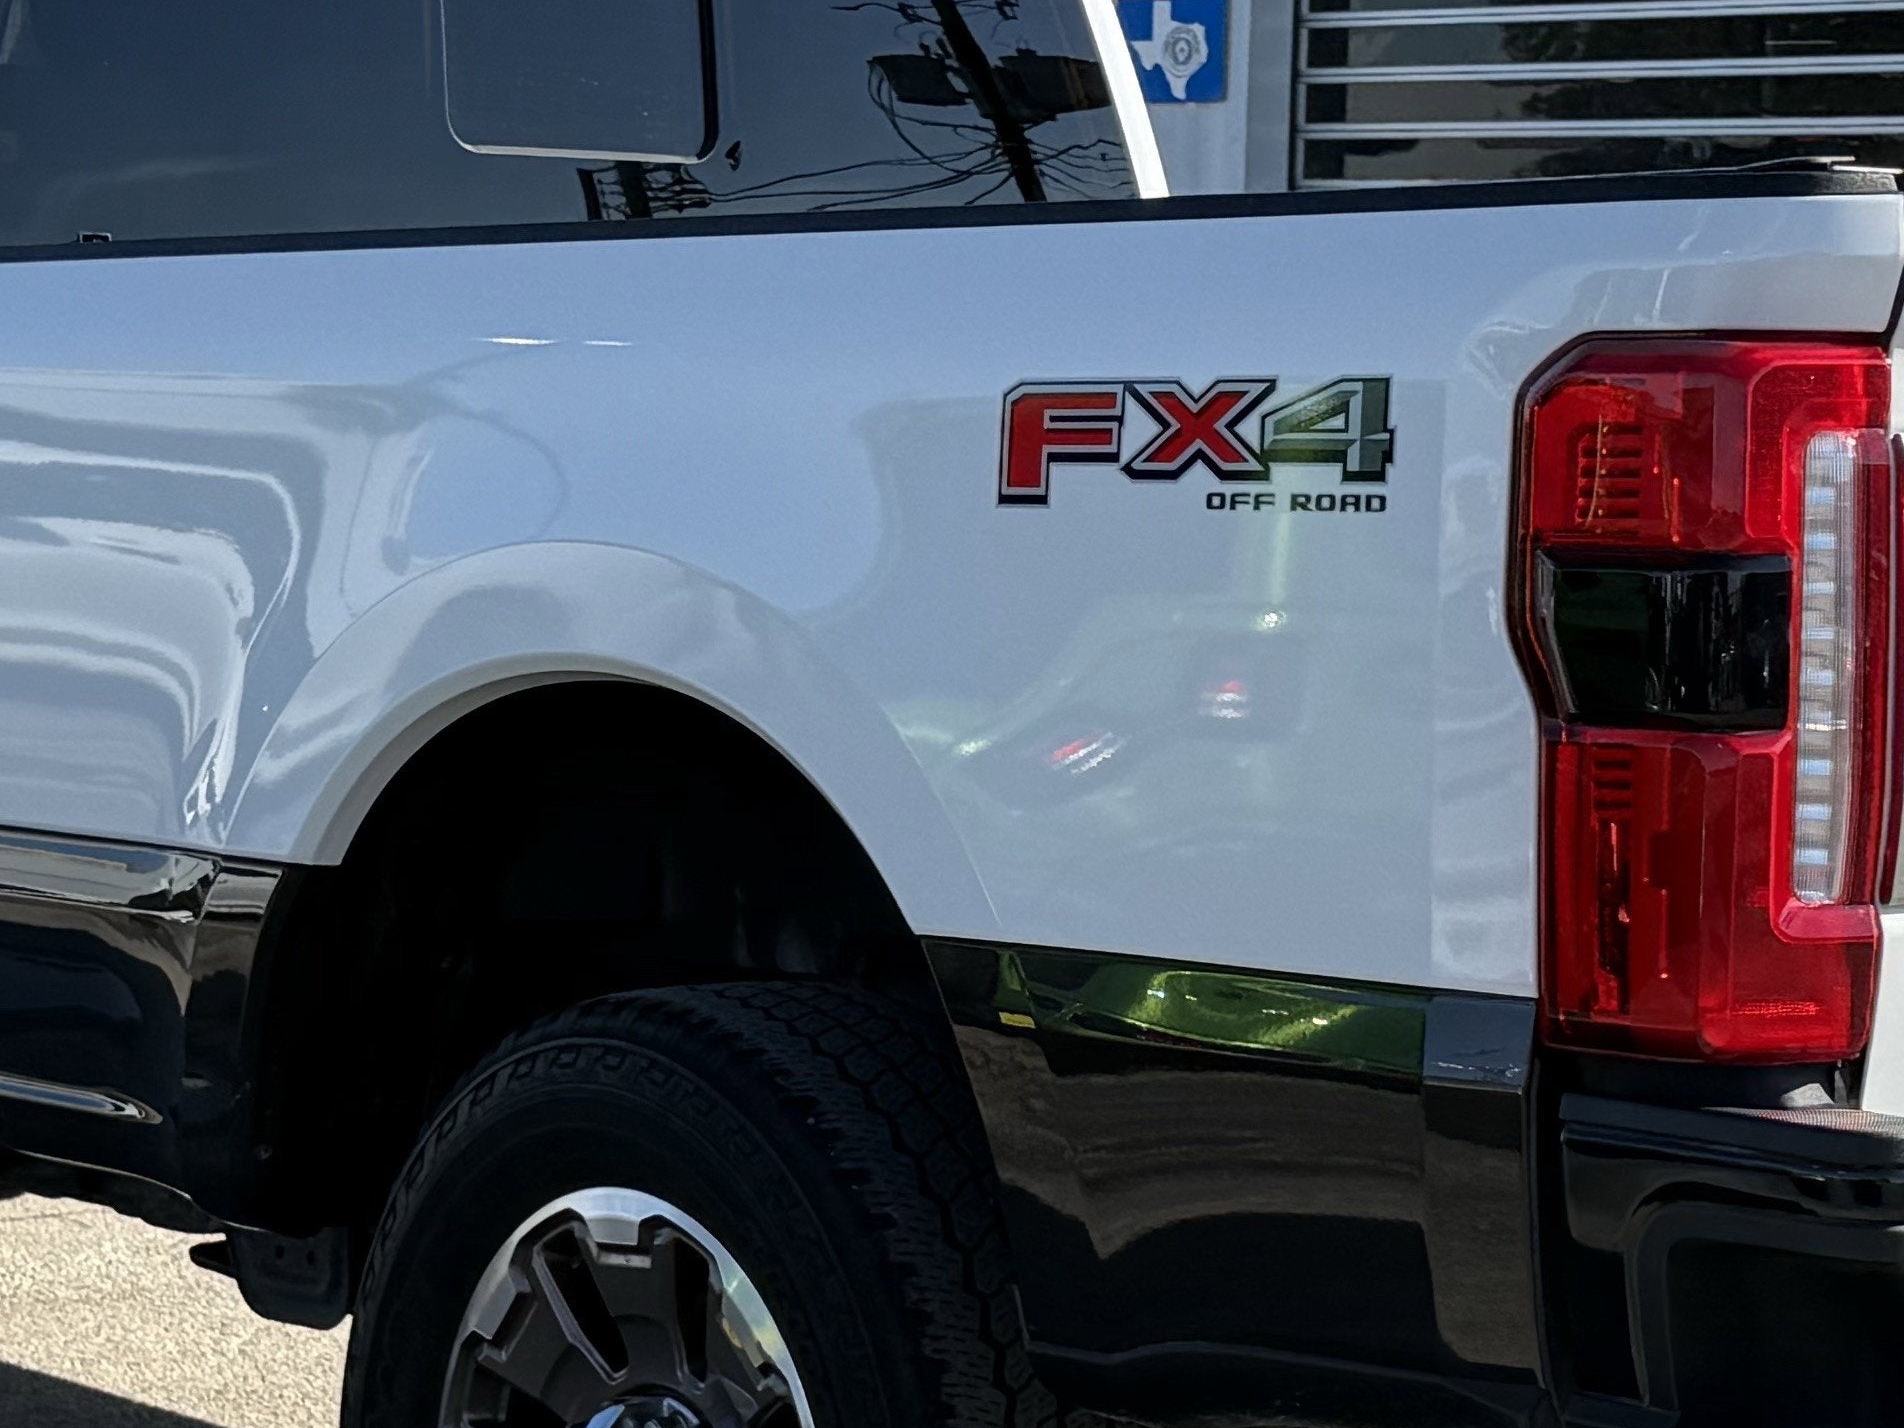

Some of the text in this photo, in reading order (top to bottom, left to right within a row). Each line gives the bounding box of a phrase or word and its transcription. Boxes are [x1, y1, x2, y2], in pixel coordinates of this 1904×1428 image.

[997, 375, 1395, 507] FX4
[1206, 491, 1387, 513] OFF ROAD
